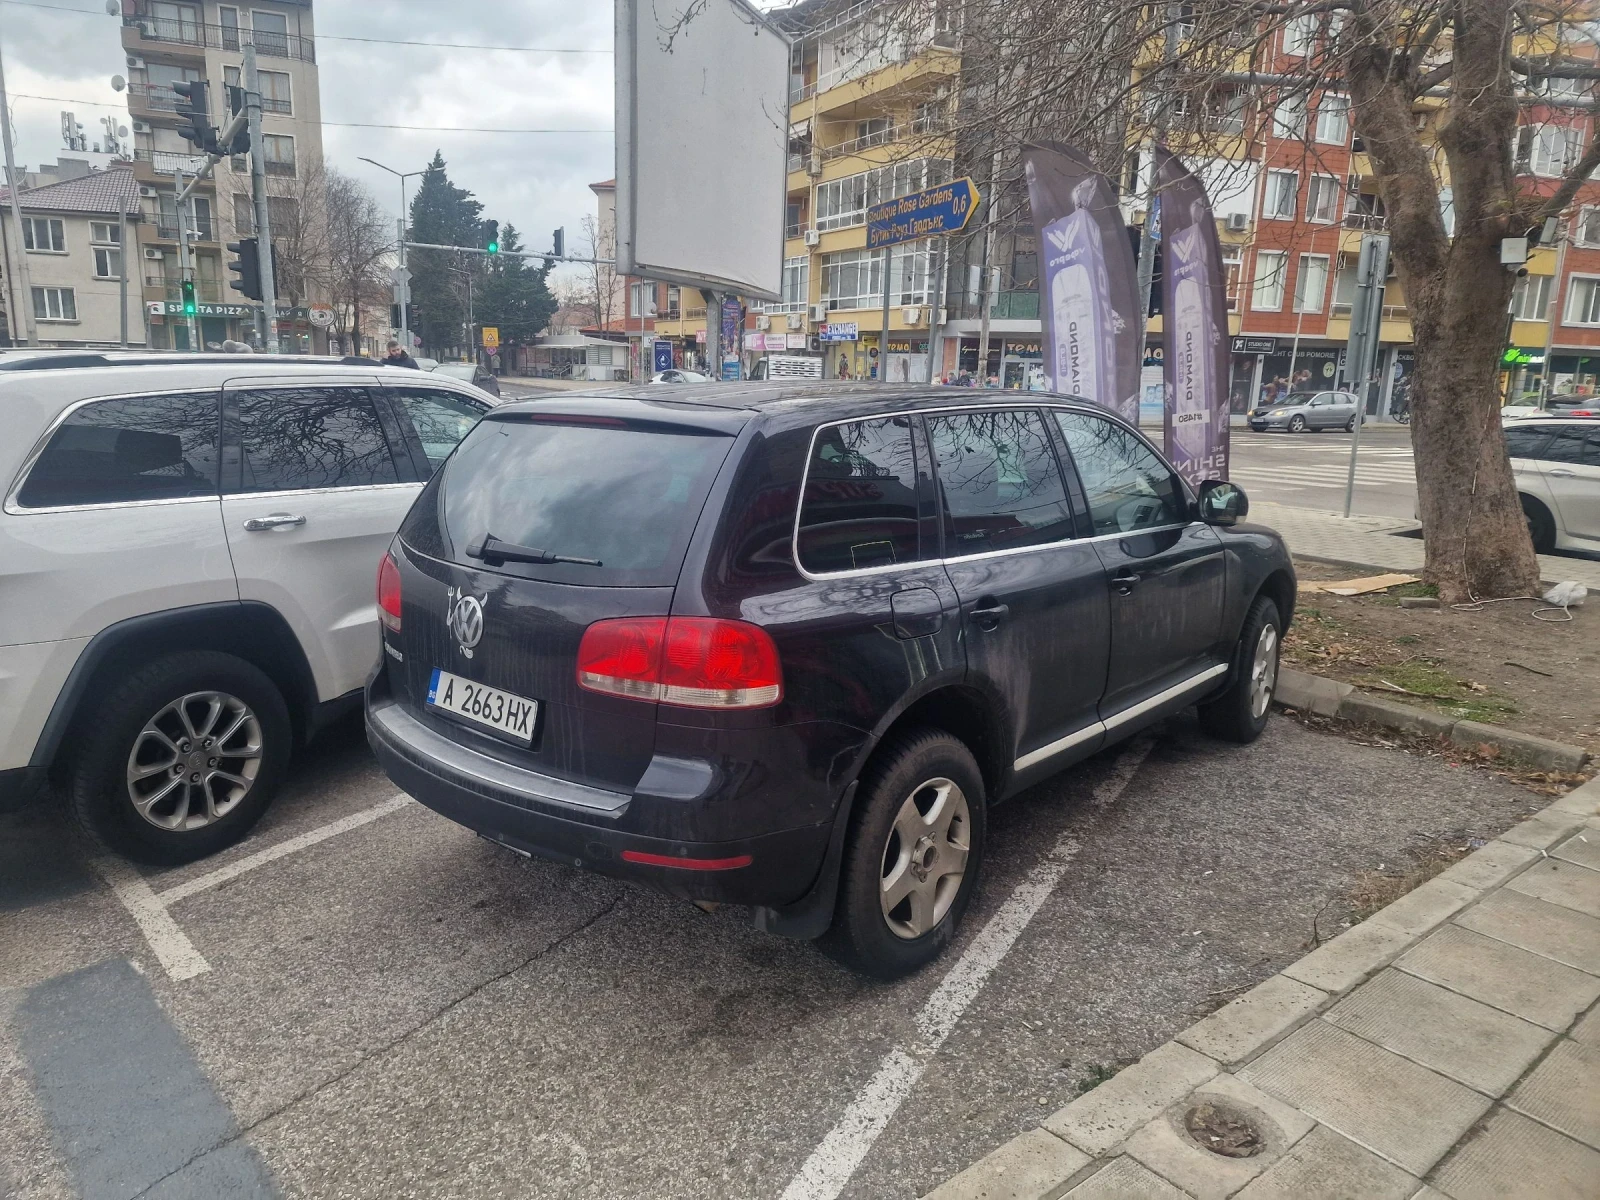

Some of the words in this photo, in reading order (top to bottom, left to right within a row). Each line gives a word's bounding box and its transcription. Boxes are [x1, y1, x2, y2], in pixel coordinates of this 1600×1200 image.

[868, 205, 897, 223] Boutique
[898, 198, 917, 214] Rose
[919, 188, 953, 209] Gardens
[952, 195, 966, 217] 0,6
[870, 228, 890, 247] Бутик
[891, 222, 908, 240] Роуз
[909, 215, 944, 236] Гардънс
[169, 304, 213, 315] SPTA
[828, 323, 857, 334] EXCHANGE
[428, 690, 436, 699] BG
[443, 678, 454, 706] A
